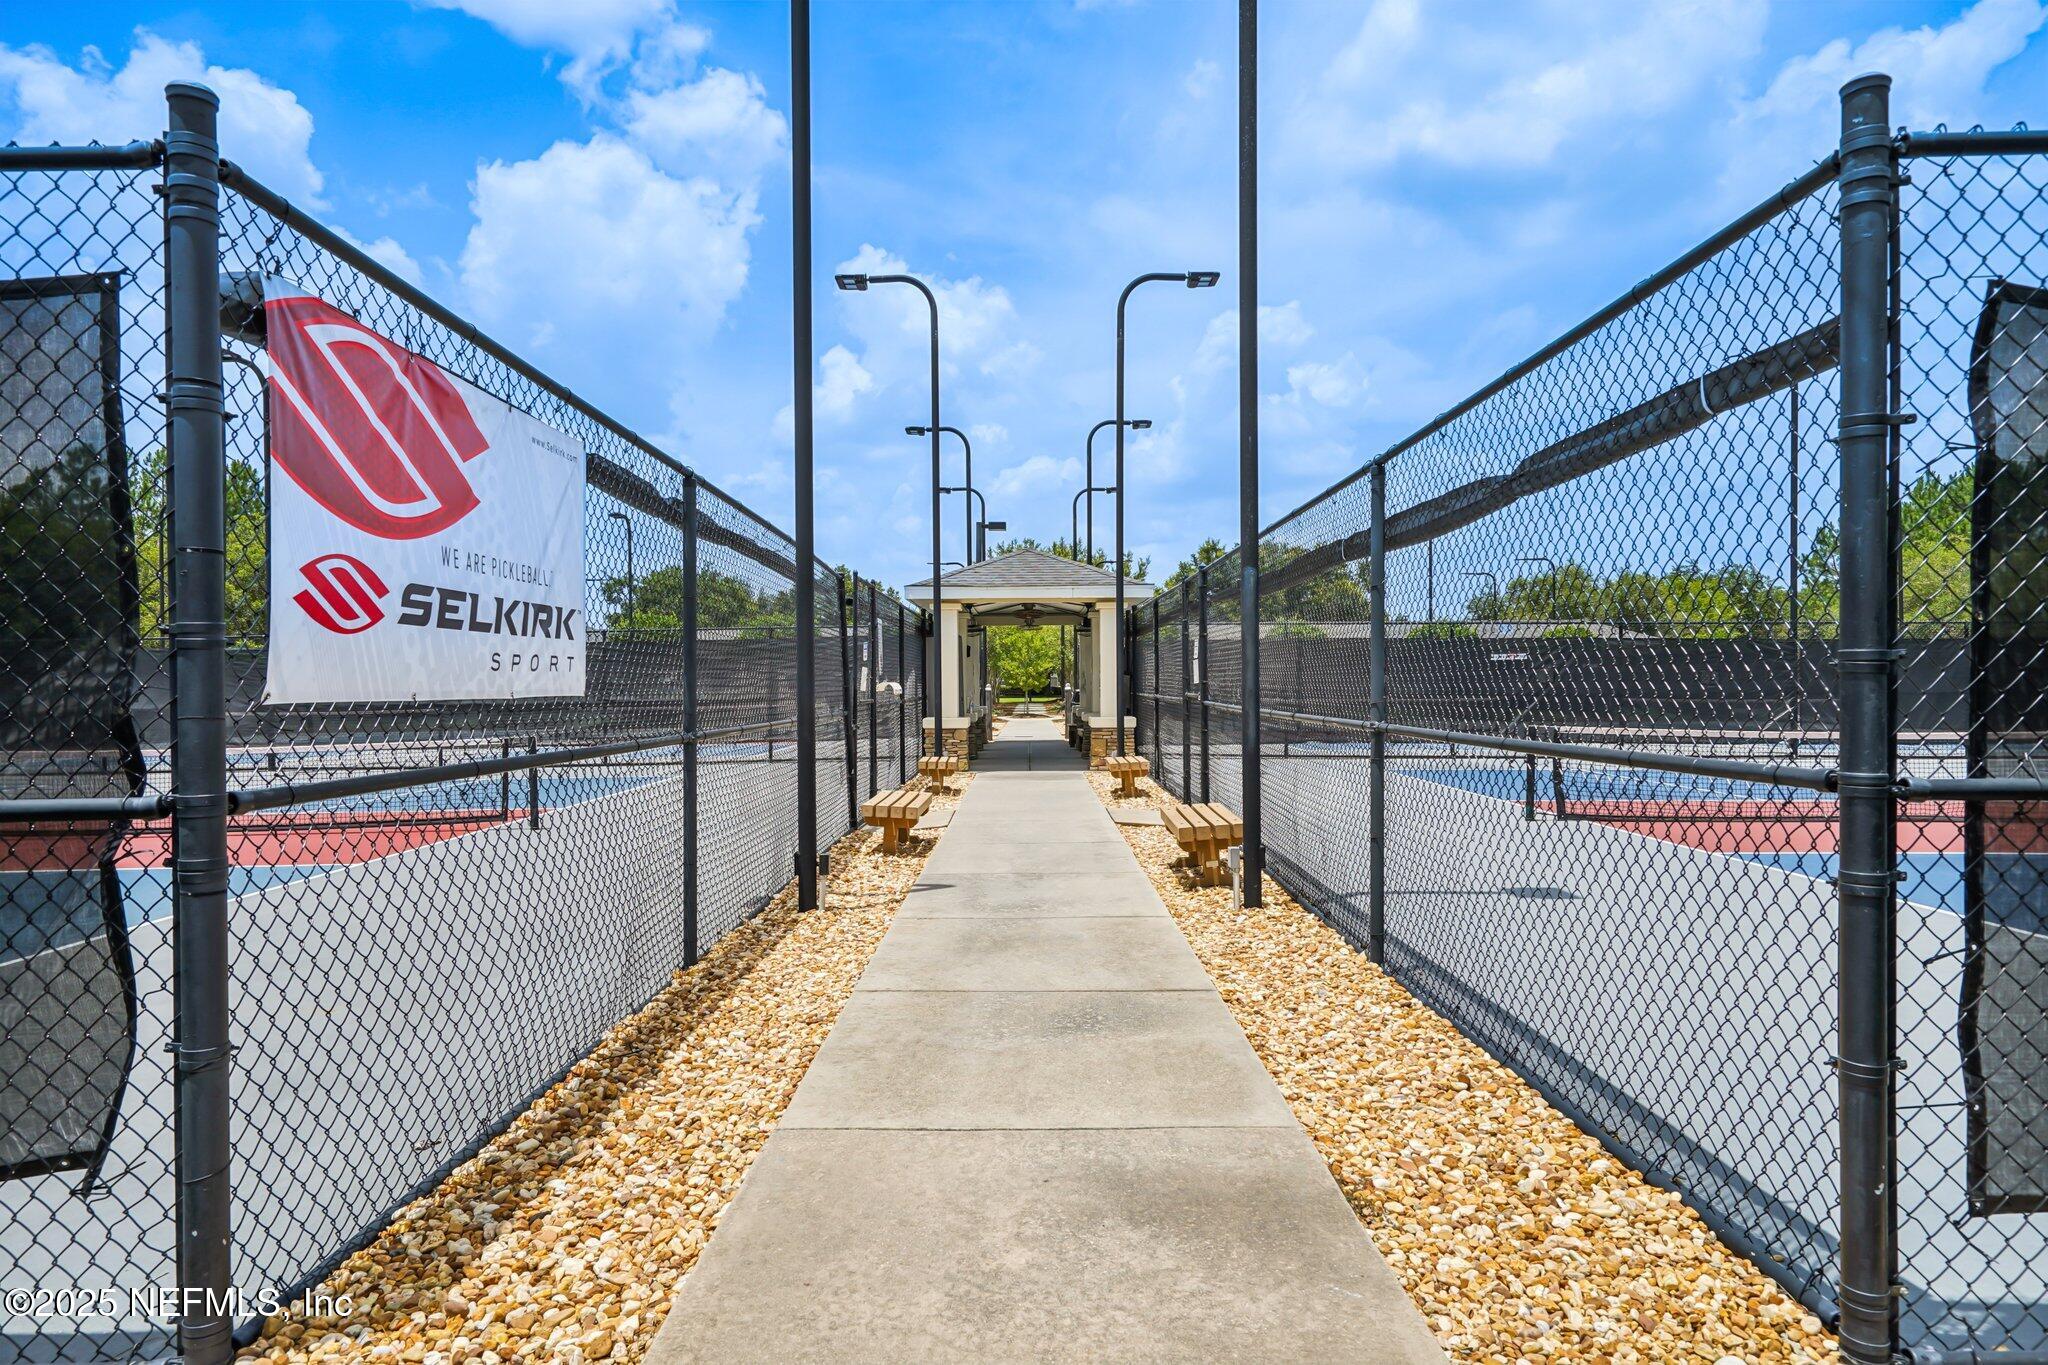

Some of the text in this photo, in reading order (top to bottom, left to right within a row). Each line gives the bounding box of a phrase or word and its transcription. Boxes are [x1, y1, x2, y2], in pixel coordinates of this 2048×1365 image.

[531, 436, 578, 463] www.Selkirk.com
[441, 545, 459, 569] WE
[466, 551, 486, 575] ARE
[397, 582, 577, 641] SELKIRK
[491, 652, 575, 672] SPORT
